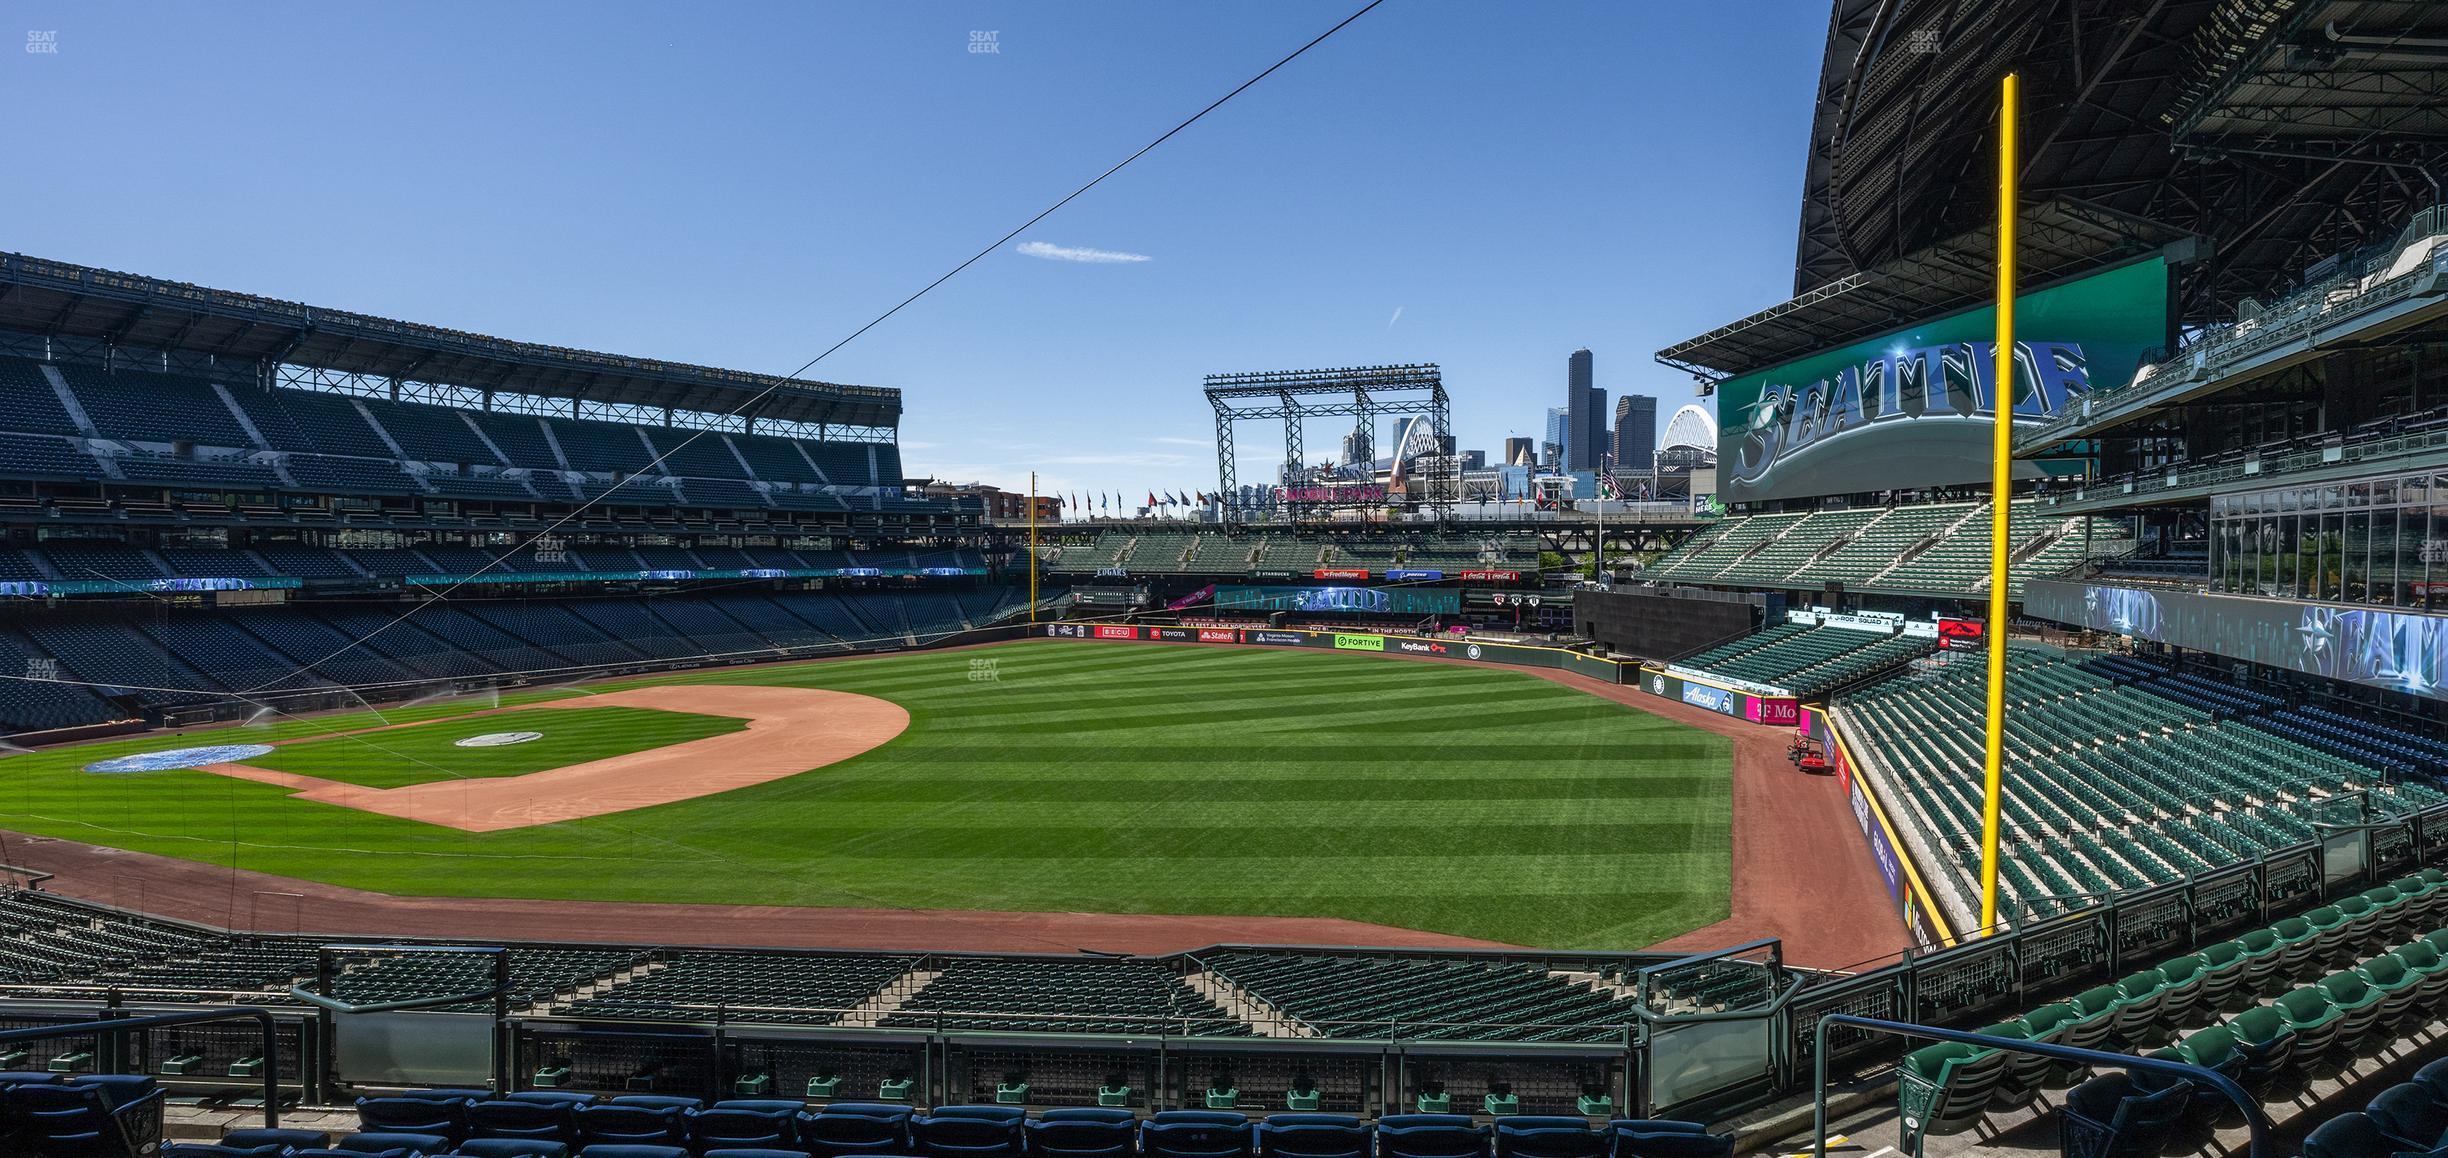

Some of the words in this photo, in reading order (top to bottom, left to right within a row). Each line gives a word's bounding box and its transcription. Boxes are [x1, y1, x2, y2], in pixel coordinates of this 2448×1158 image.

[1343, 485, 1384, 501] PARK
[1858, 617, 1882, 625] SQUAD
[1348, 638, 1381, 647] FORTIVE
[1401, 641, 1430, 652] KeyBank
[1685, 686, 1717, 707] Alaska
